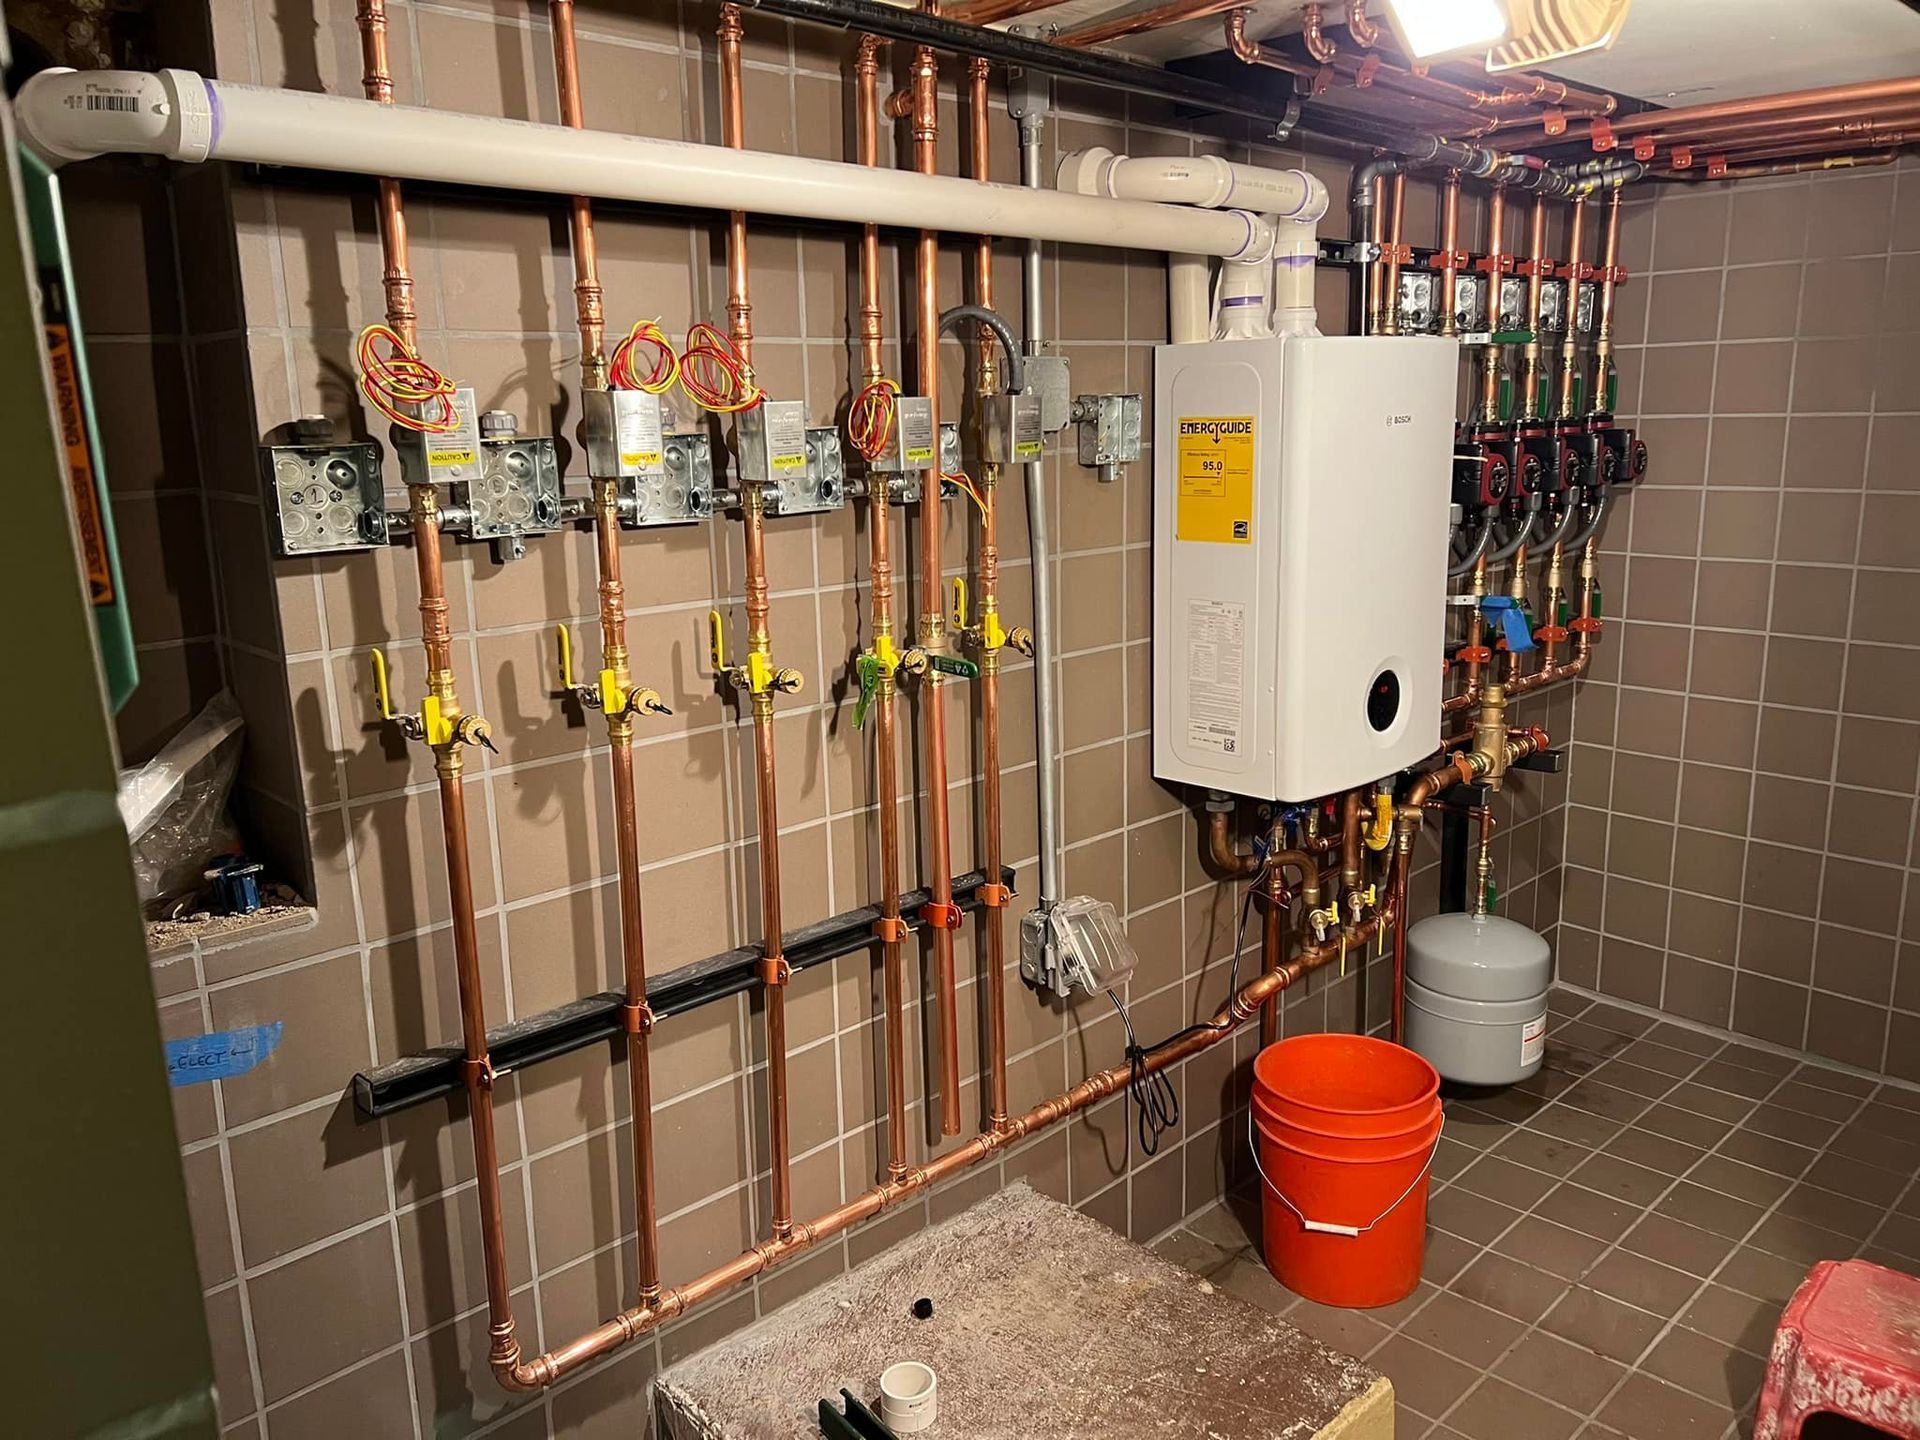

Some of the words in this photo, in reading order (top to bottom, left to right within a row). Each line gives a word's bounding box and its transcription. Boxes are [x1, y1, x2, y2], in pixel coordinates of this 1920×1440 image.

[52, 355, 81, 446] WARNING
[1394, 415, 1411, 424] BOSCH
[1202, 461, 1223, 471] 95.0
